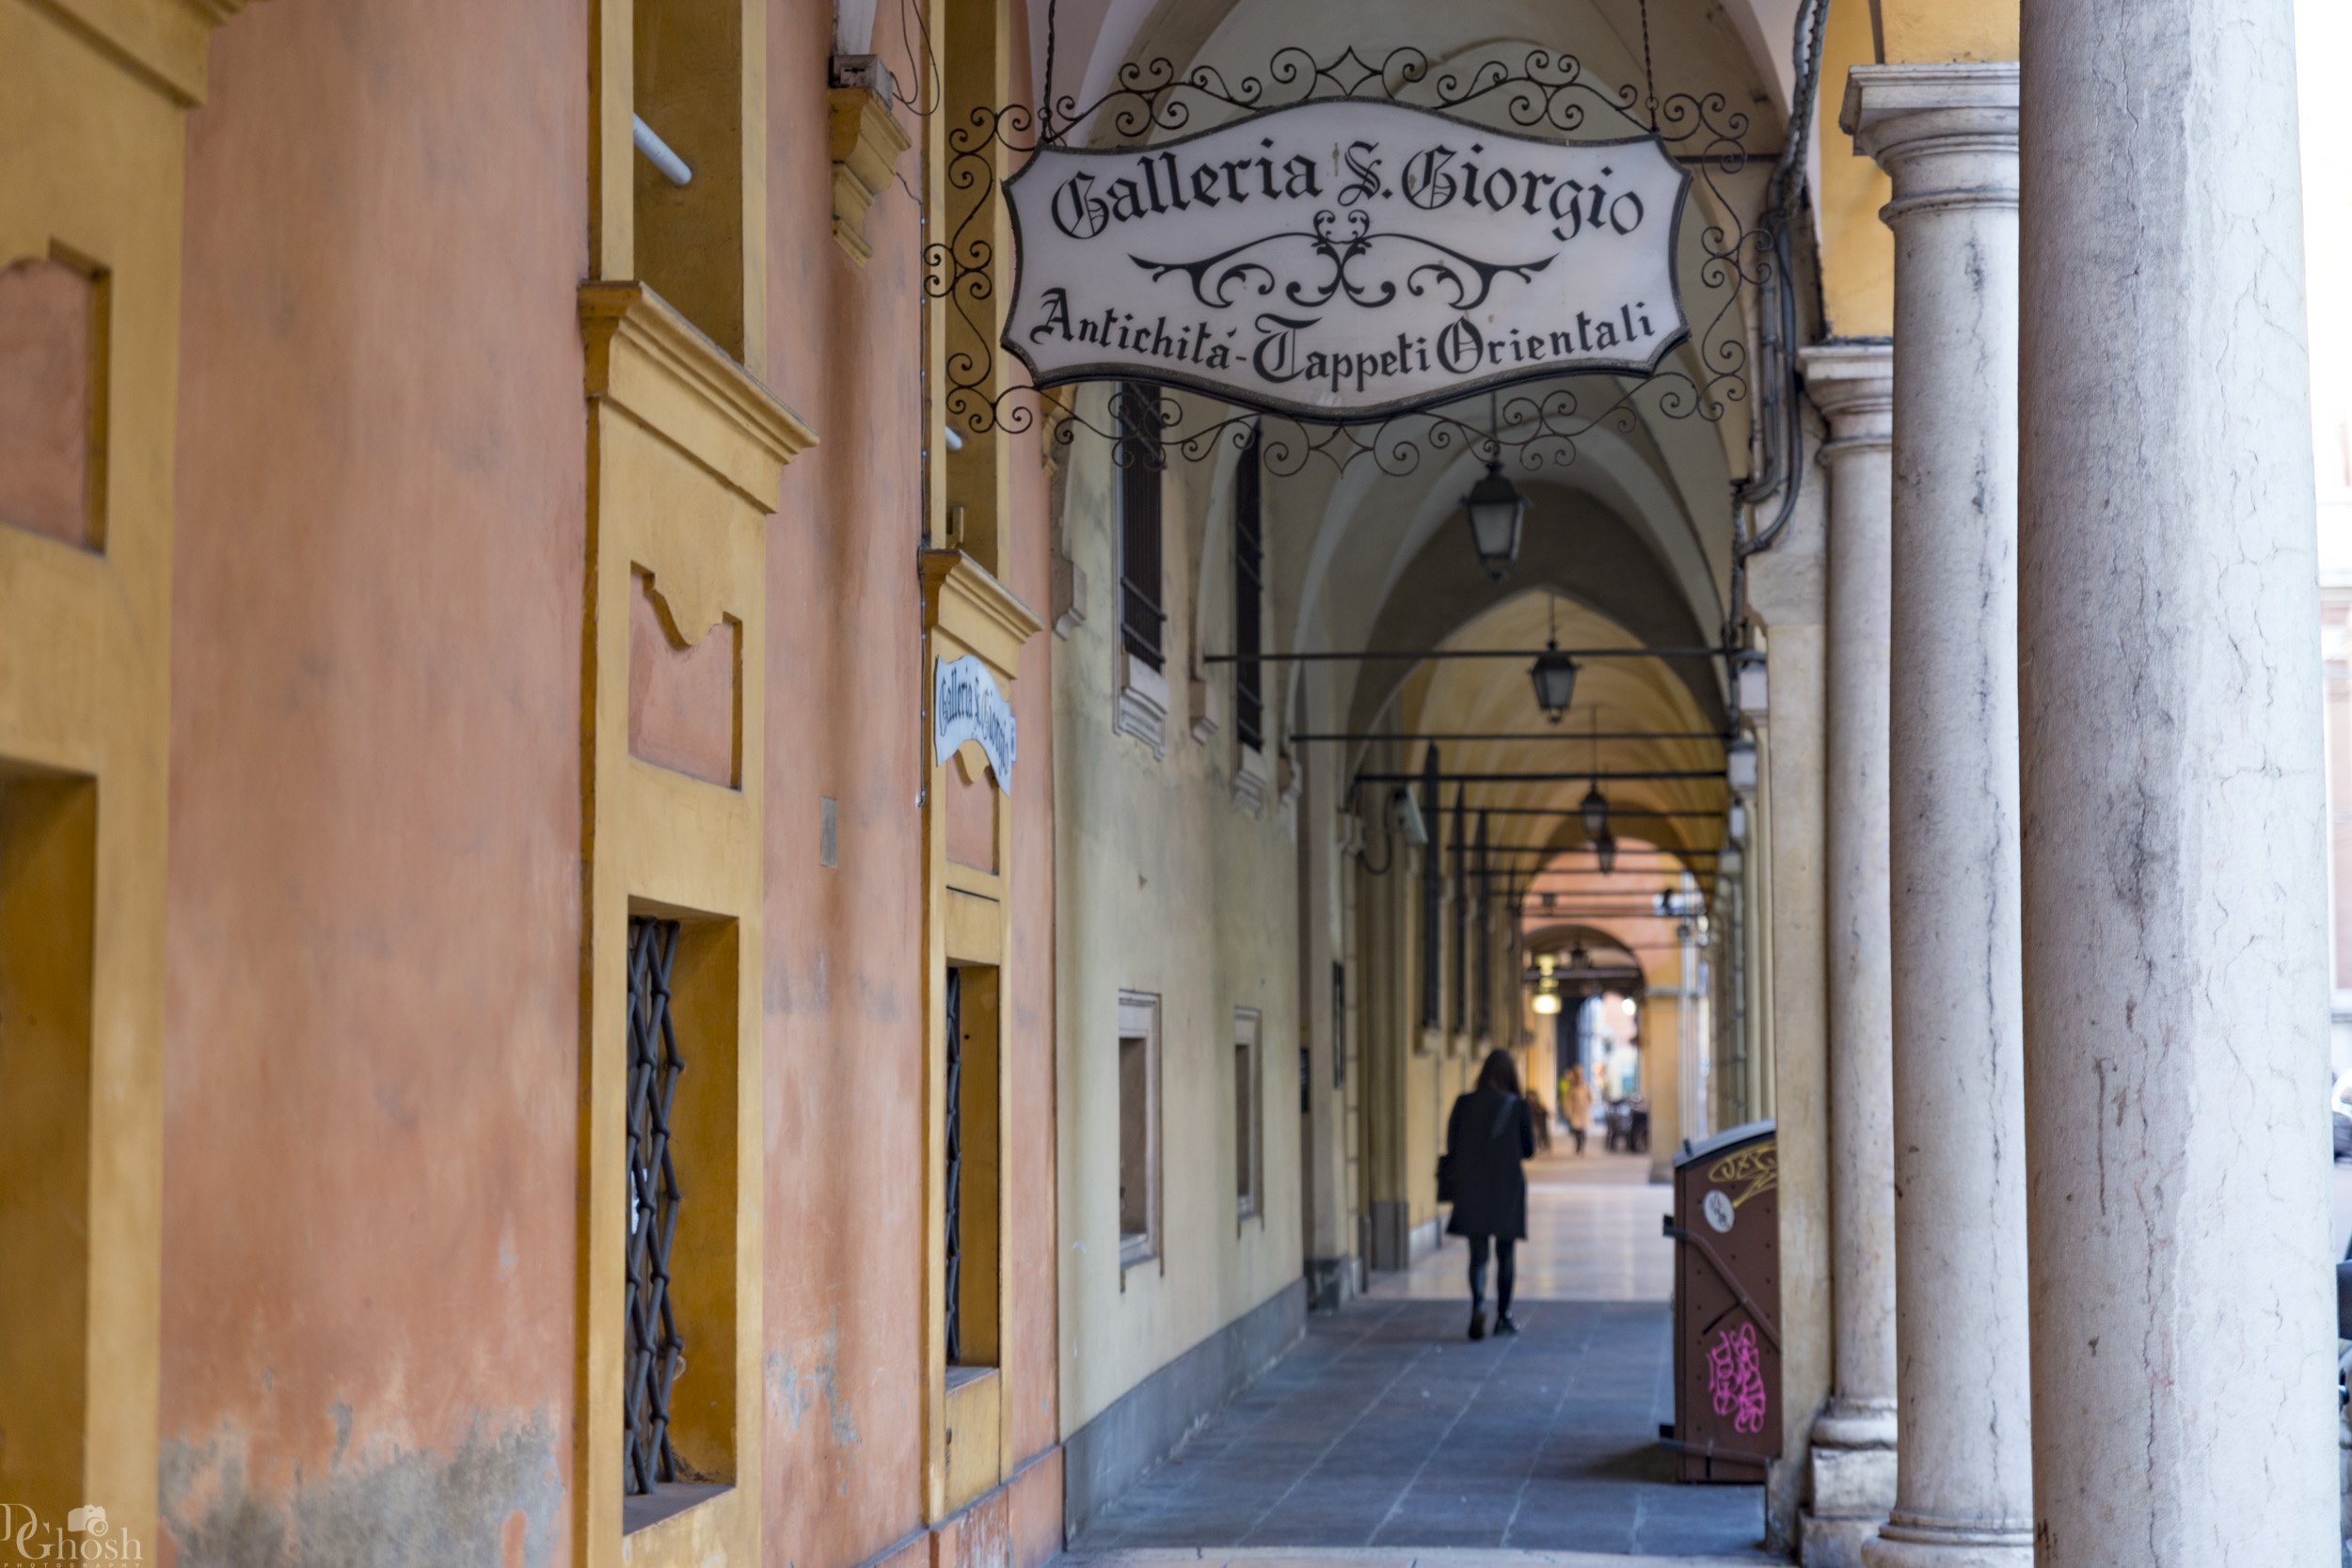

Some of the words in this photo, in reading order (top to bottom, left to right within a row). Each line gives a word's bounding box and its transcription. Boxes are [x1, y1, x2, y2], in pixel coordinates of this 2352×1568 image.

[1051, 137, 1324, 240] Galleria
[1337, 141, 1393, 206] S.
[1402, 143, 1645, 242] Giorgio
[1436, 301, 1656, 375] Orientali
[938, 666, 973, 737] Galleria
